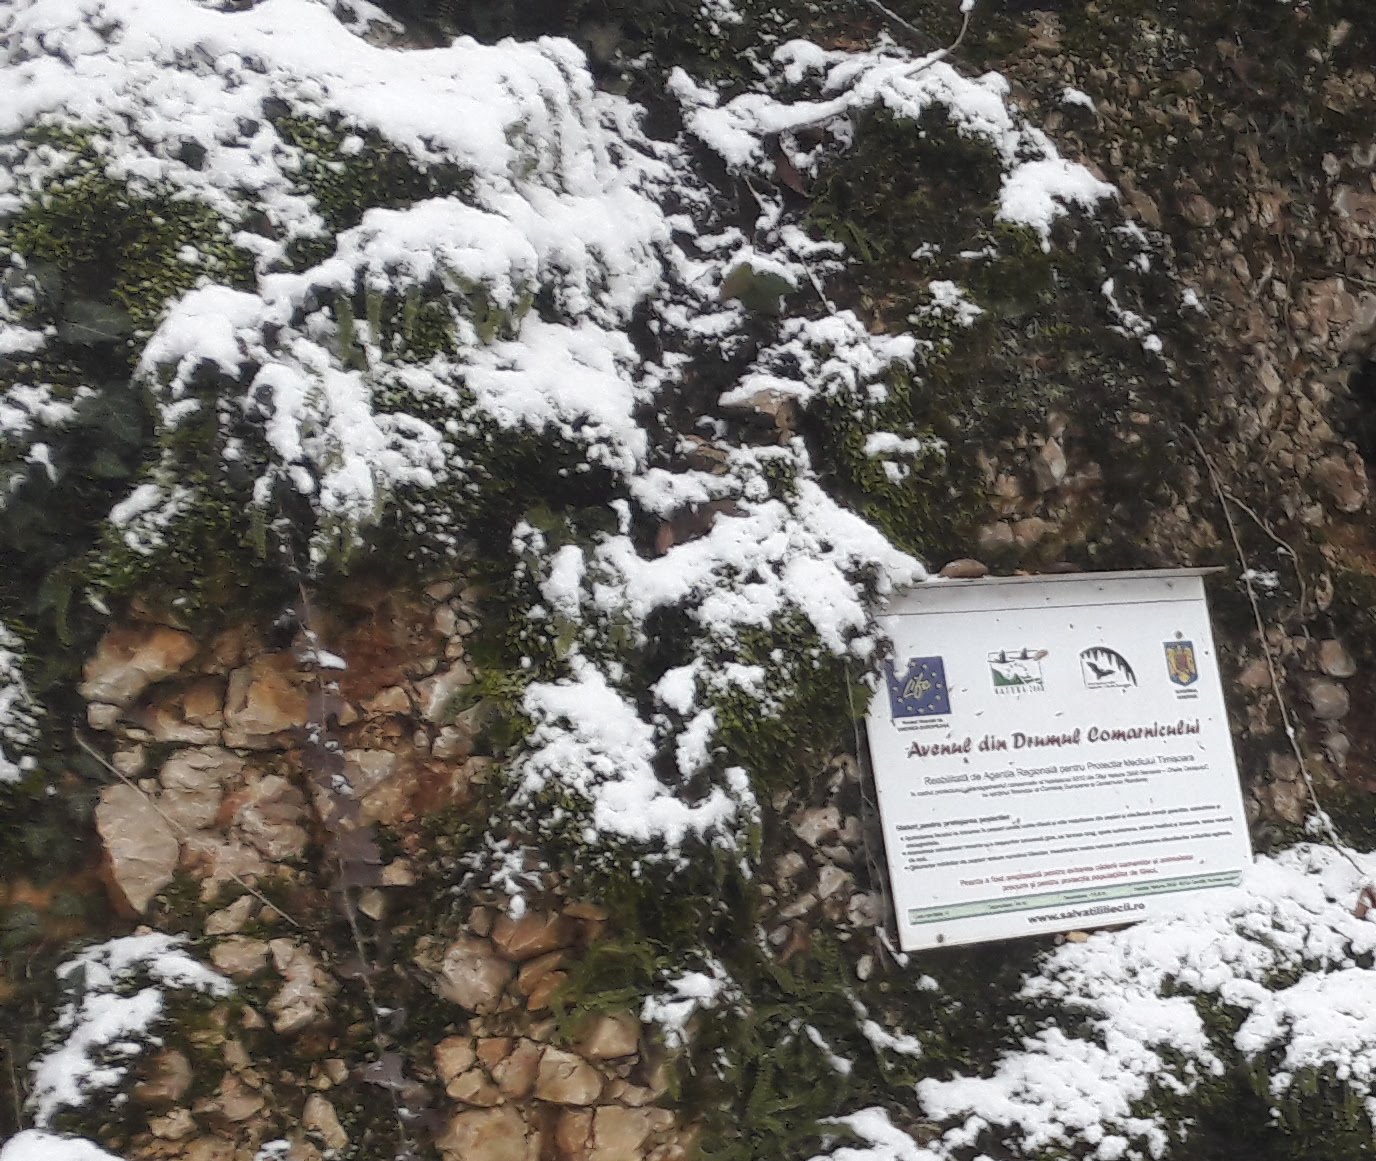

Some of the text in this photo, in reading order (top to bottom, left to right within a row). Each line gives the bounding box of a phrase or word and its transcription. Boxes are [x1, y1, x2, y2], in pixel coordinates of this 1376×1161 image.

[907, 718, 1200, 759] Avenul din Drumul Comarnicului
